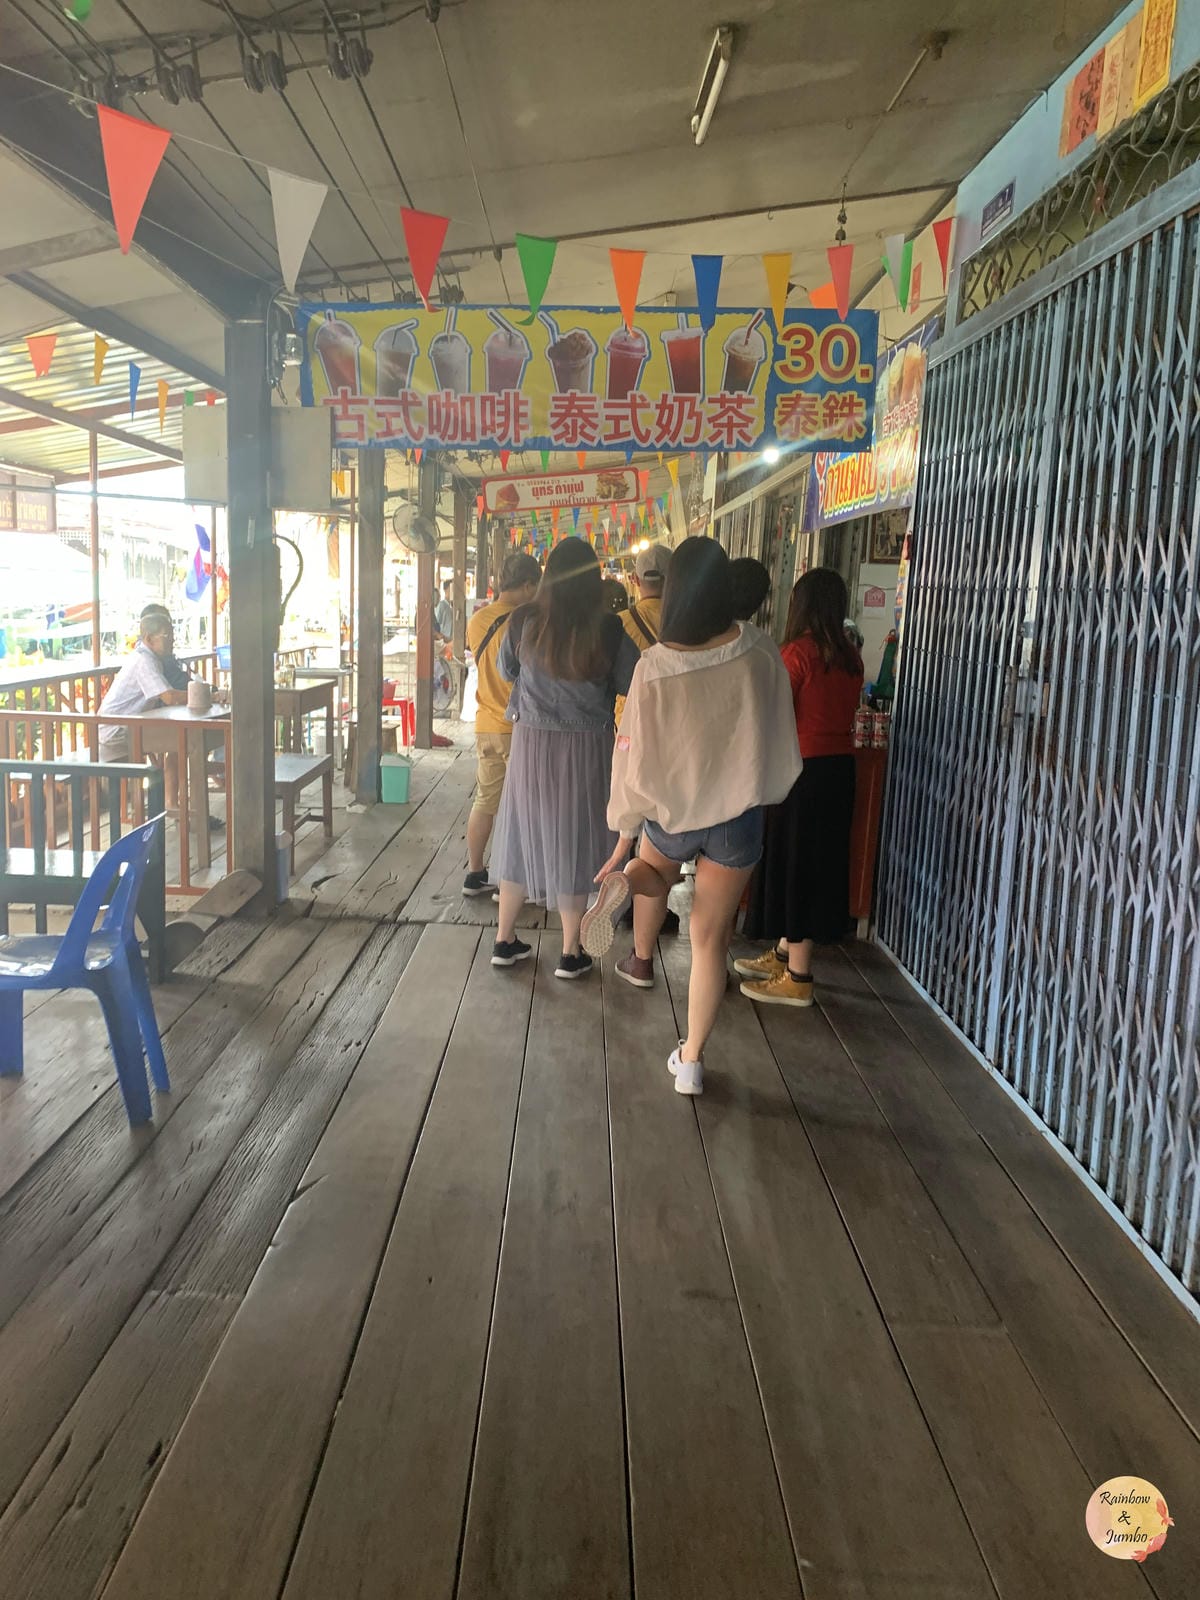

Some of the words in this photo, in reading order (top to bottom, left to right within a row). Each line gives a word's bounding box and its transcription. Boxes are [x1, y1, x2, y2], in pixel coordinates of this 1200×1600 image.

[323, 389, 529, 444] 古式咖啡
[550, 392, 758, 445] 泰式奶茶
[778, 393, 865, 439] 泰銖
